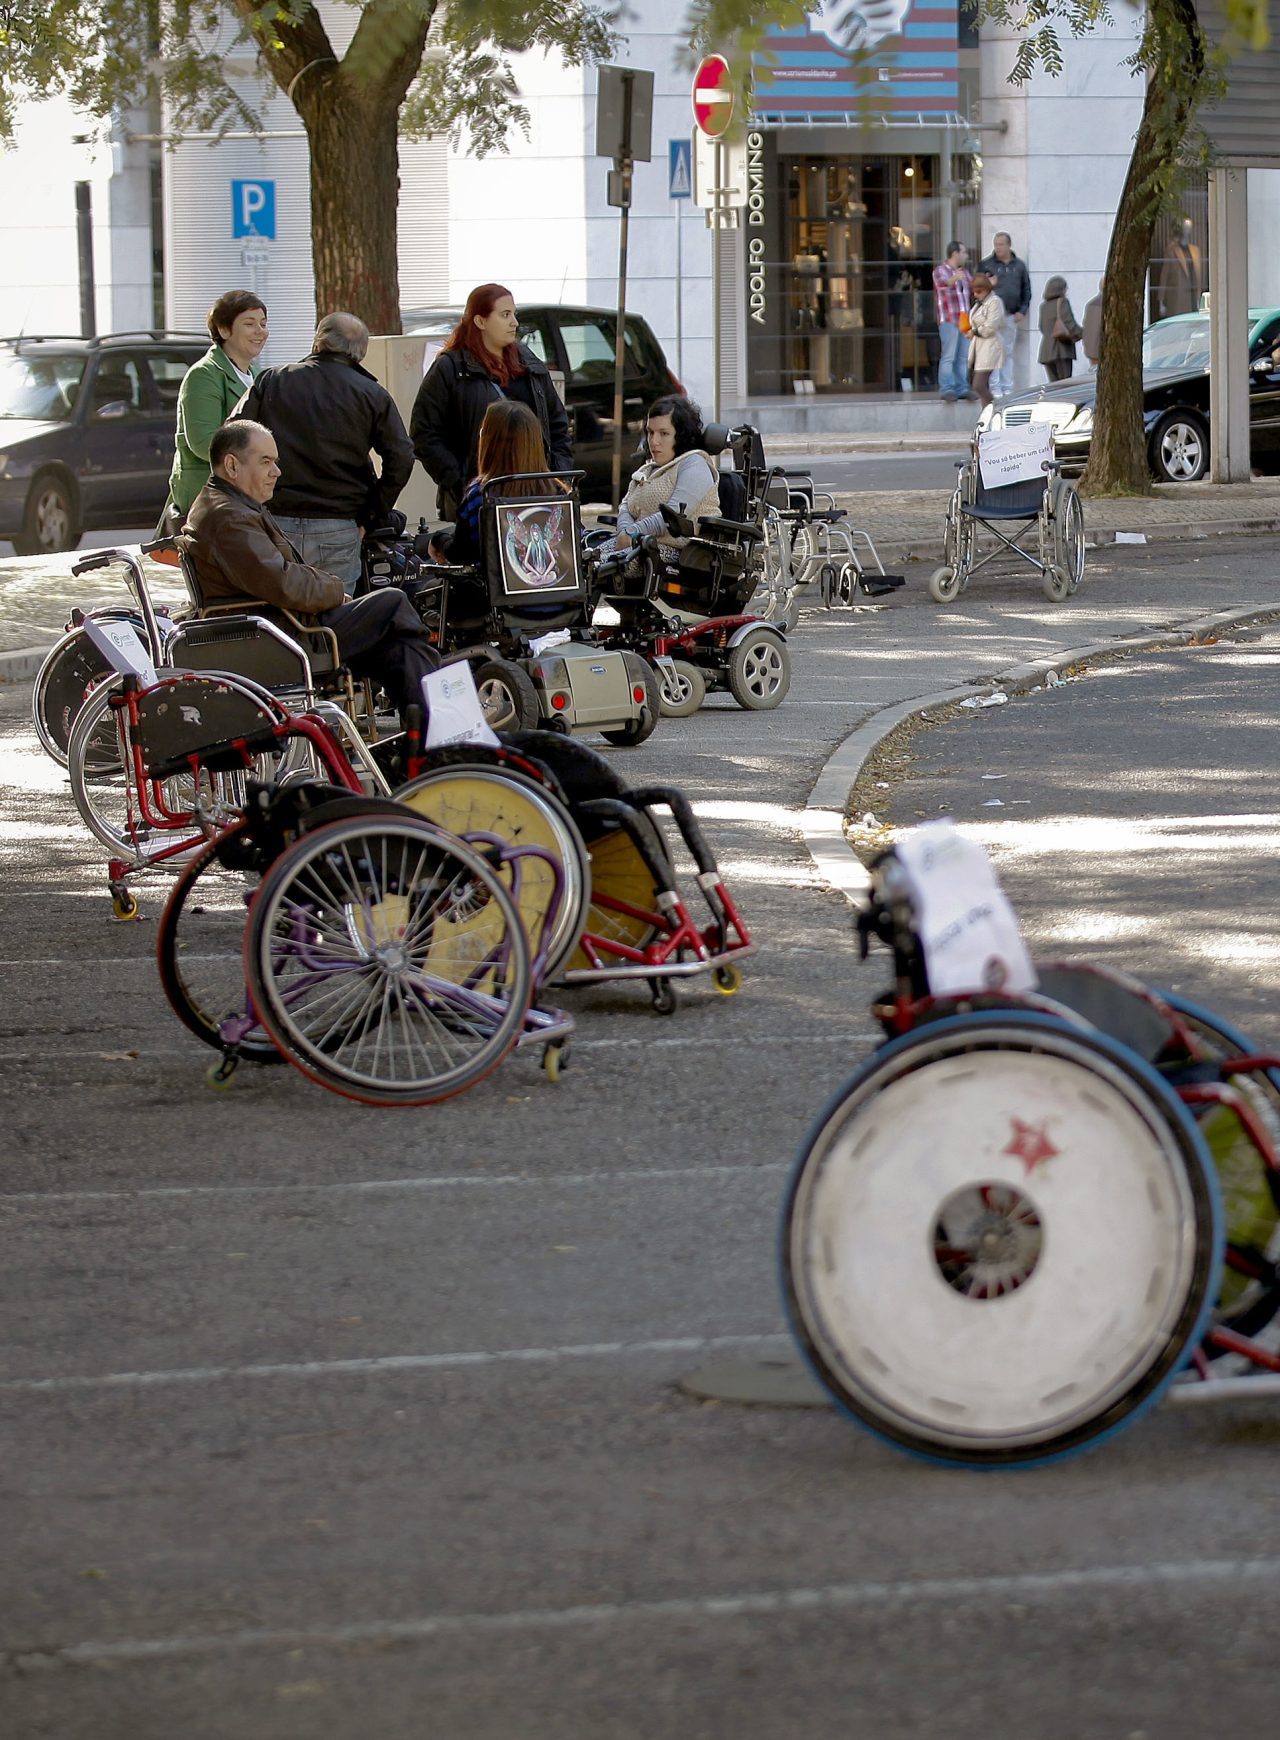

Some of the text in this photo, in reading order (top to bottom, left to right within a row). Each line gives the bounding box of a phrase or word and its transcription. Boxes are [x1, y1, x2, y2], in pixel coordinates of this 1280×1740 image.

[242, 183, 266, 226] P
[748, 131, 767, 325] ADOLFO DOMING
[1009, 452, 1027, 461] beber
